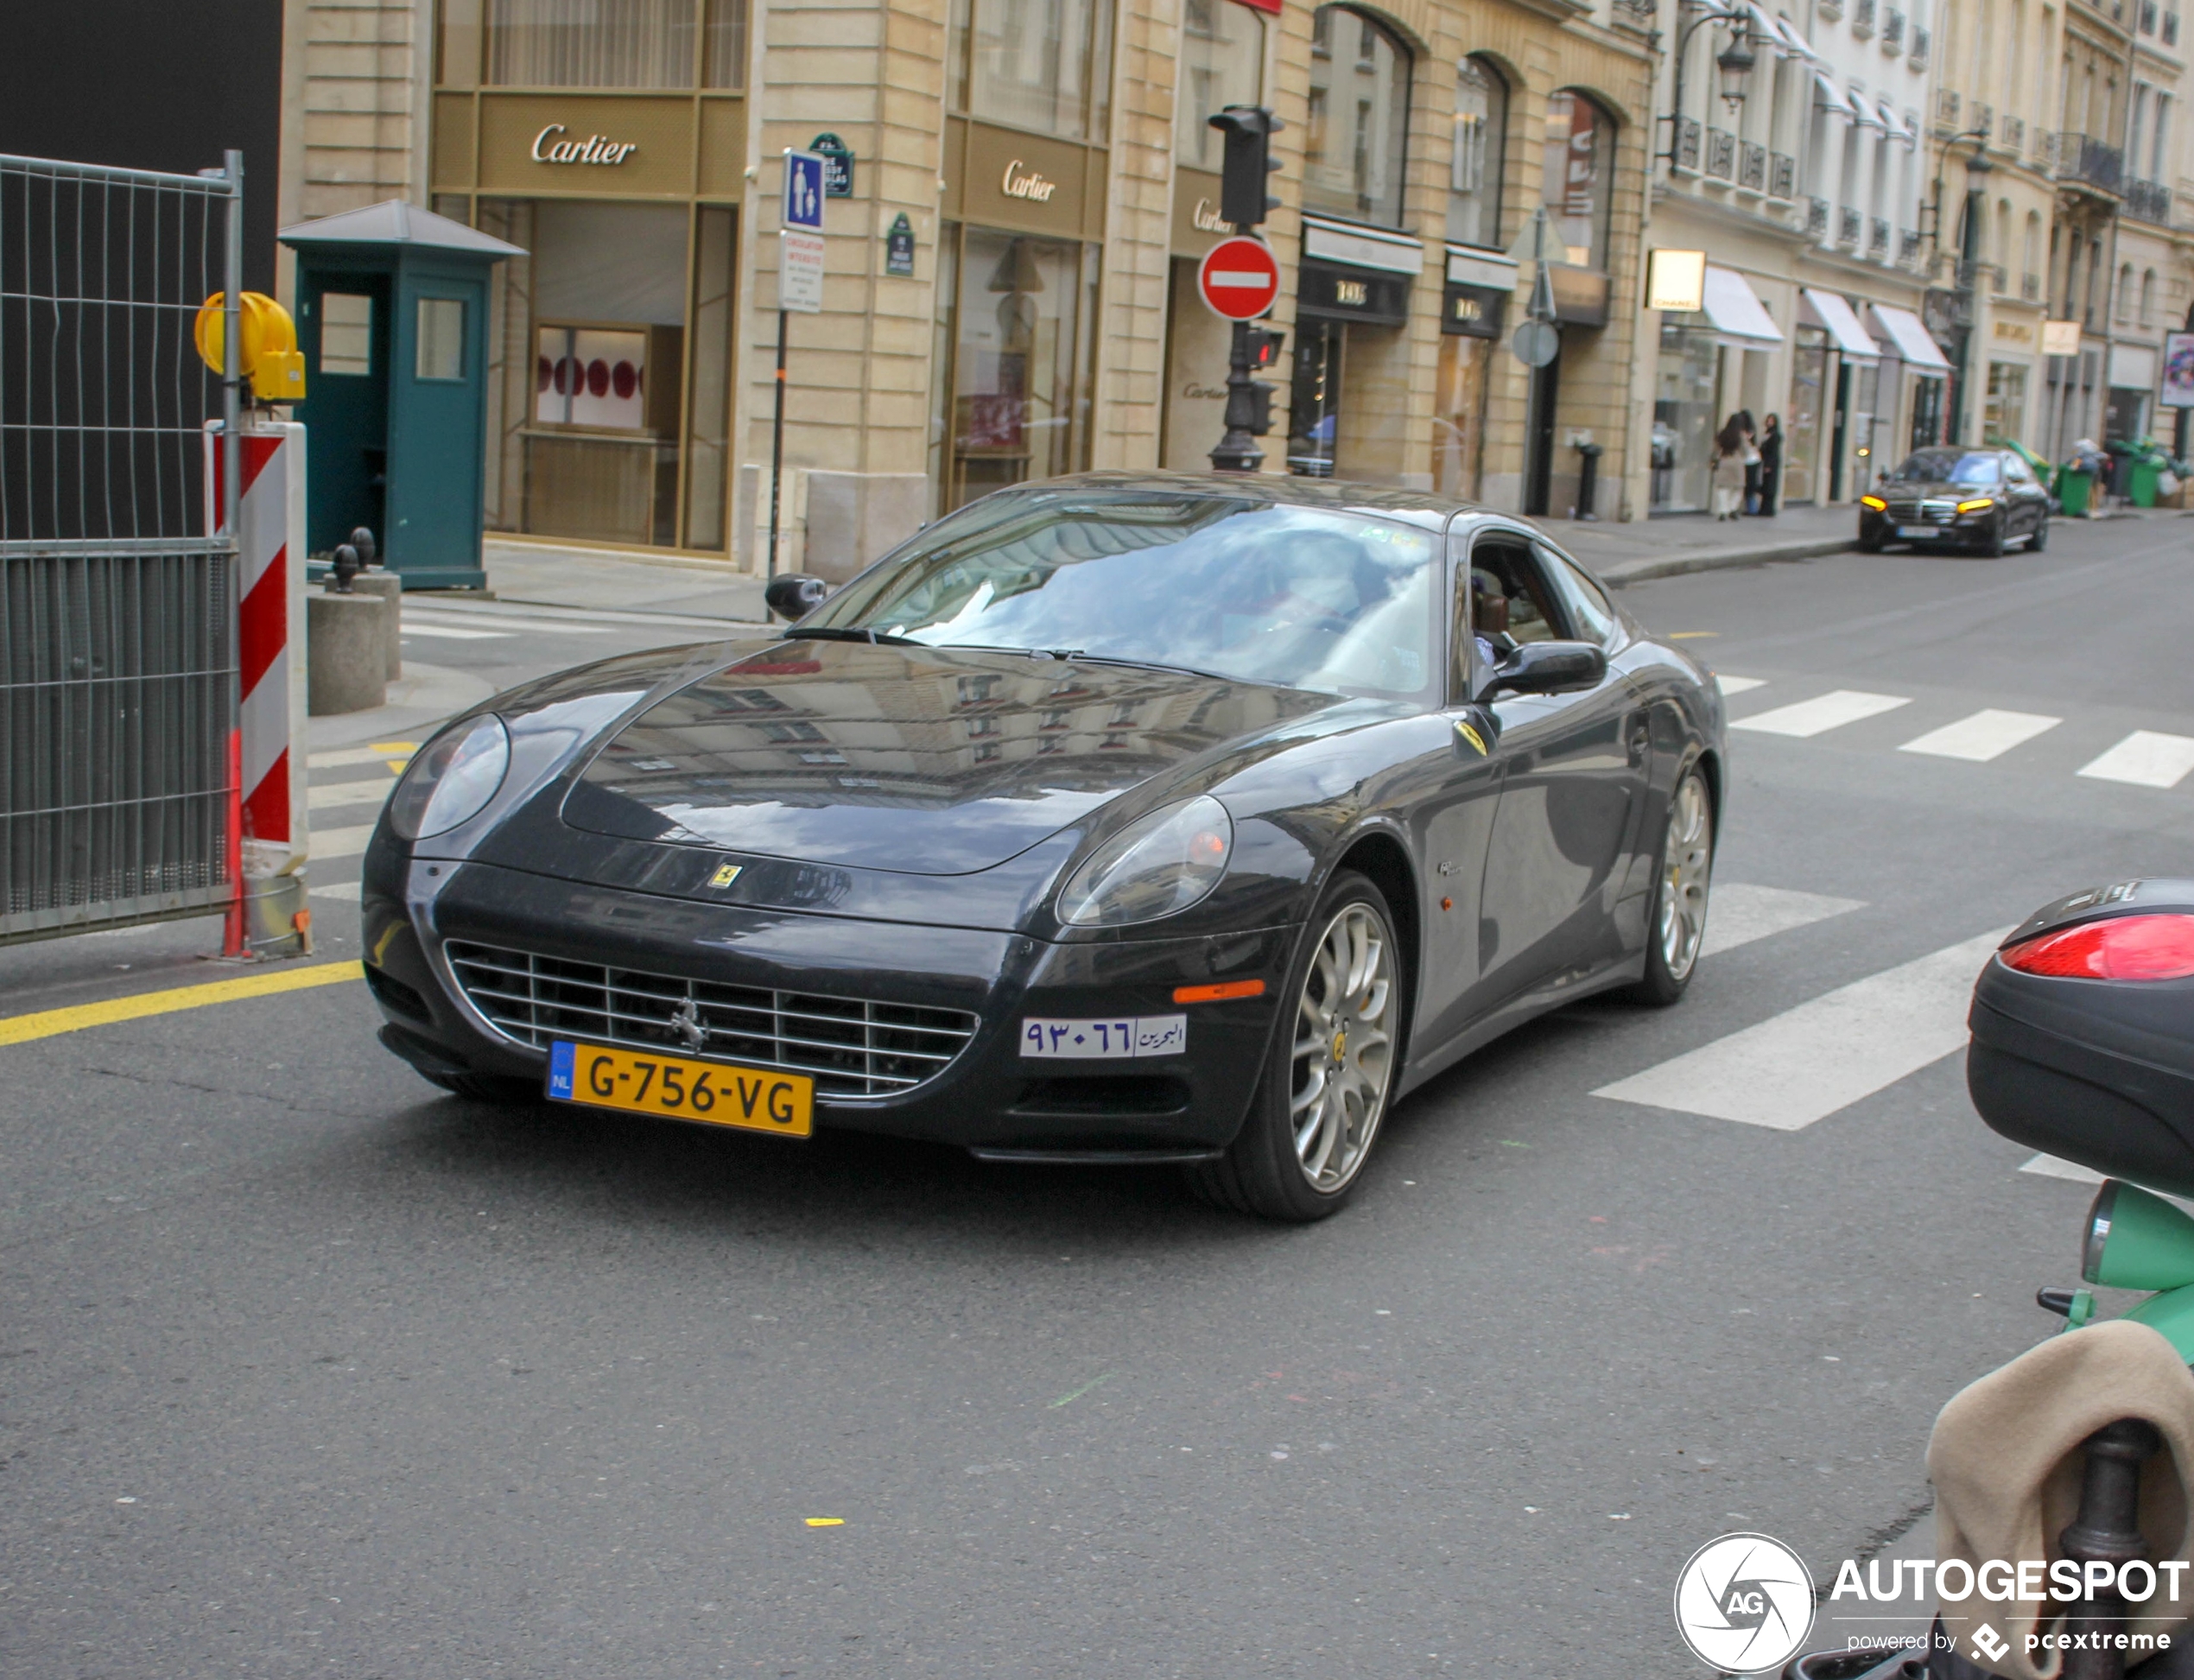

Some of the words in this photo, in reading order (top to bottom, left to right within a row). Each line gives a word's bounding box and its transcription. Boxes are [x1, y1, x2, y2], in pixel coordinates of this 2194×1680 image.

[531, 124, 636, 164] Cartier
[1002, 159, 1056, 202] Cartier
[1654, 299, 1699, 307] CHANEL
[1027, 1023, 1130, 1054] ٩٣٠٦٦
[1139, 1024, 1183, 1049] البحرين
[553, 1075, 570, 1090] NL
[589, 1056, 794, 1124] G-756-VG
